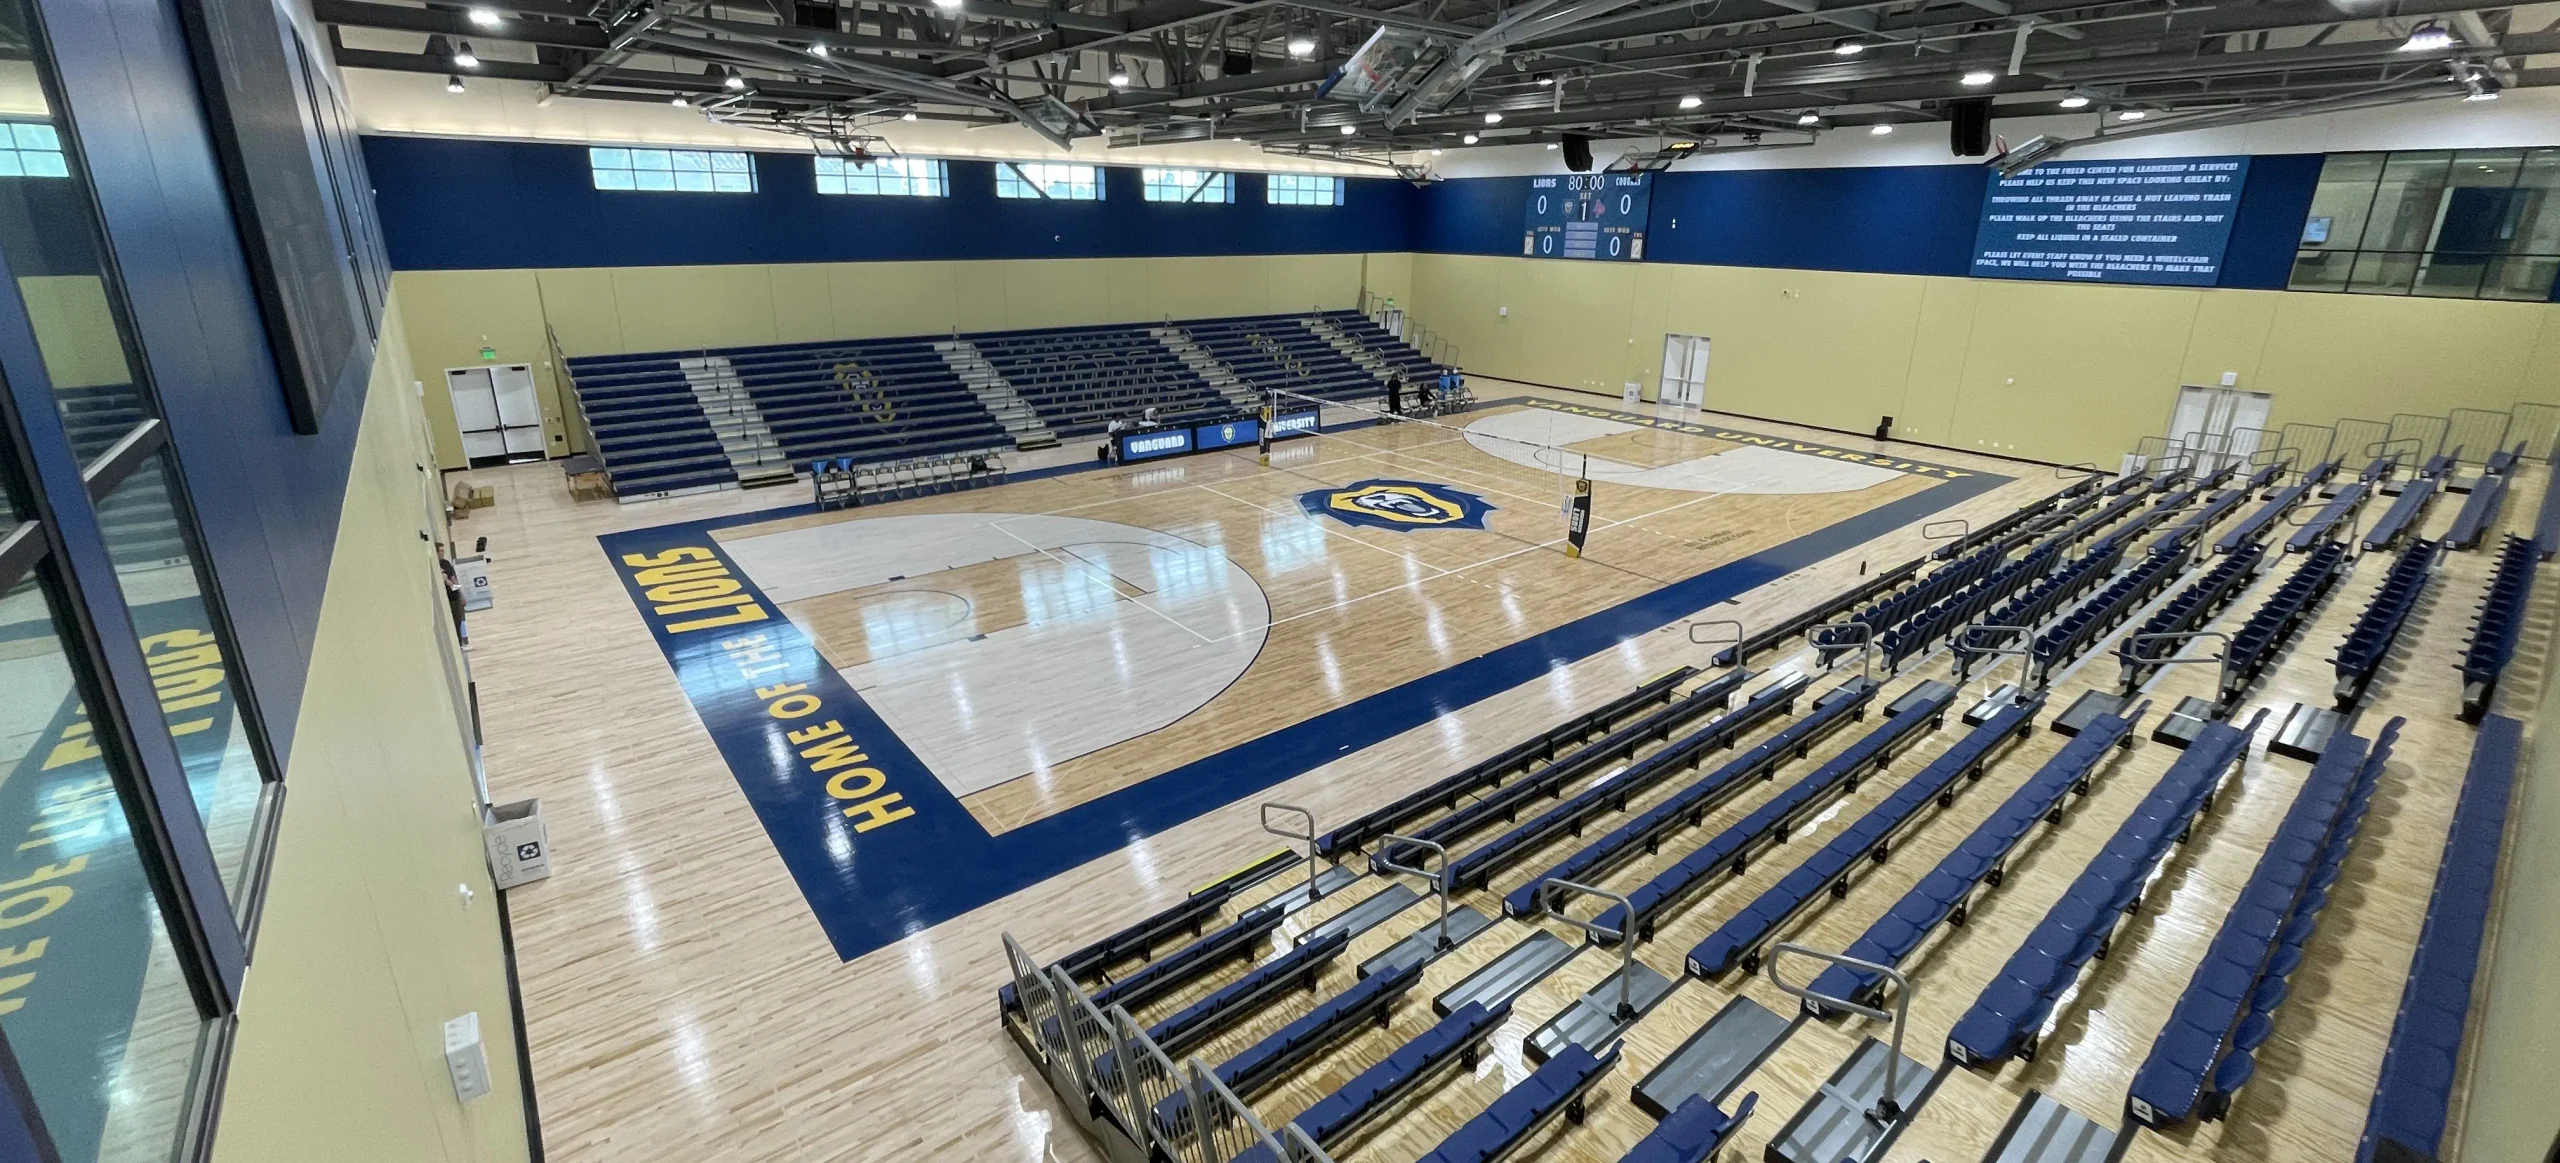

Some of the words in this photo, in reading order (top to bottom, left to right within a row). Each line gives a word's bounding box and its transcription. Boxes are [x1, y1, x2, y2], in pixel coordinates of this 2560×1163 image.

[2199, 163, 2238, 171] SERVICE!
[1533, 178, 1557, 188] LIONS
[1568, 175, 1605, 191] 80:00
[1537, 195, 1548, 215] 0
[1580, 192, 1592, 200] SET
[1620, 194, 1632, 215] 0
[1581, 201, 1587, 221] 1
[1543, 235, 1553, 254] 0
[1610, 236, 1620, 256] 0
[2155, 255, 2209, 263] WHEELCHAIR
[1130, 435, 1185, 454] VANGUARD
[1527, 399, 1704, 433] VANGUARD
[1715, 431, 1974, 478] UNIVERSITY
[1570, 508, 1580, 533] LIONS
[622, 547, 769, 634] LIONS
[721, 634, 790, 681] THE
[755, 683, 822, 719] OF
[787, 719, 916, 834] HOME
